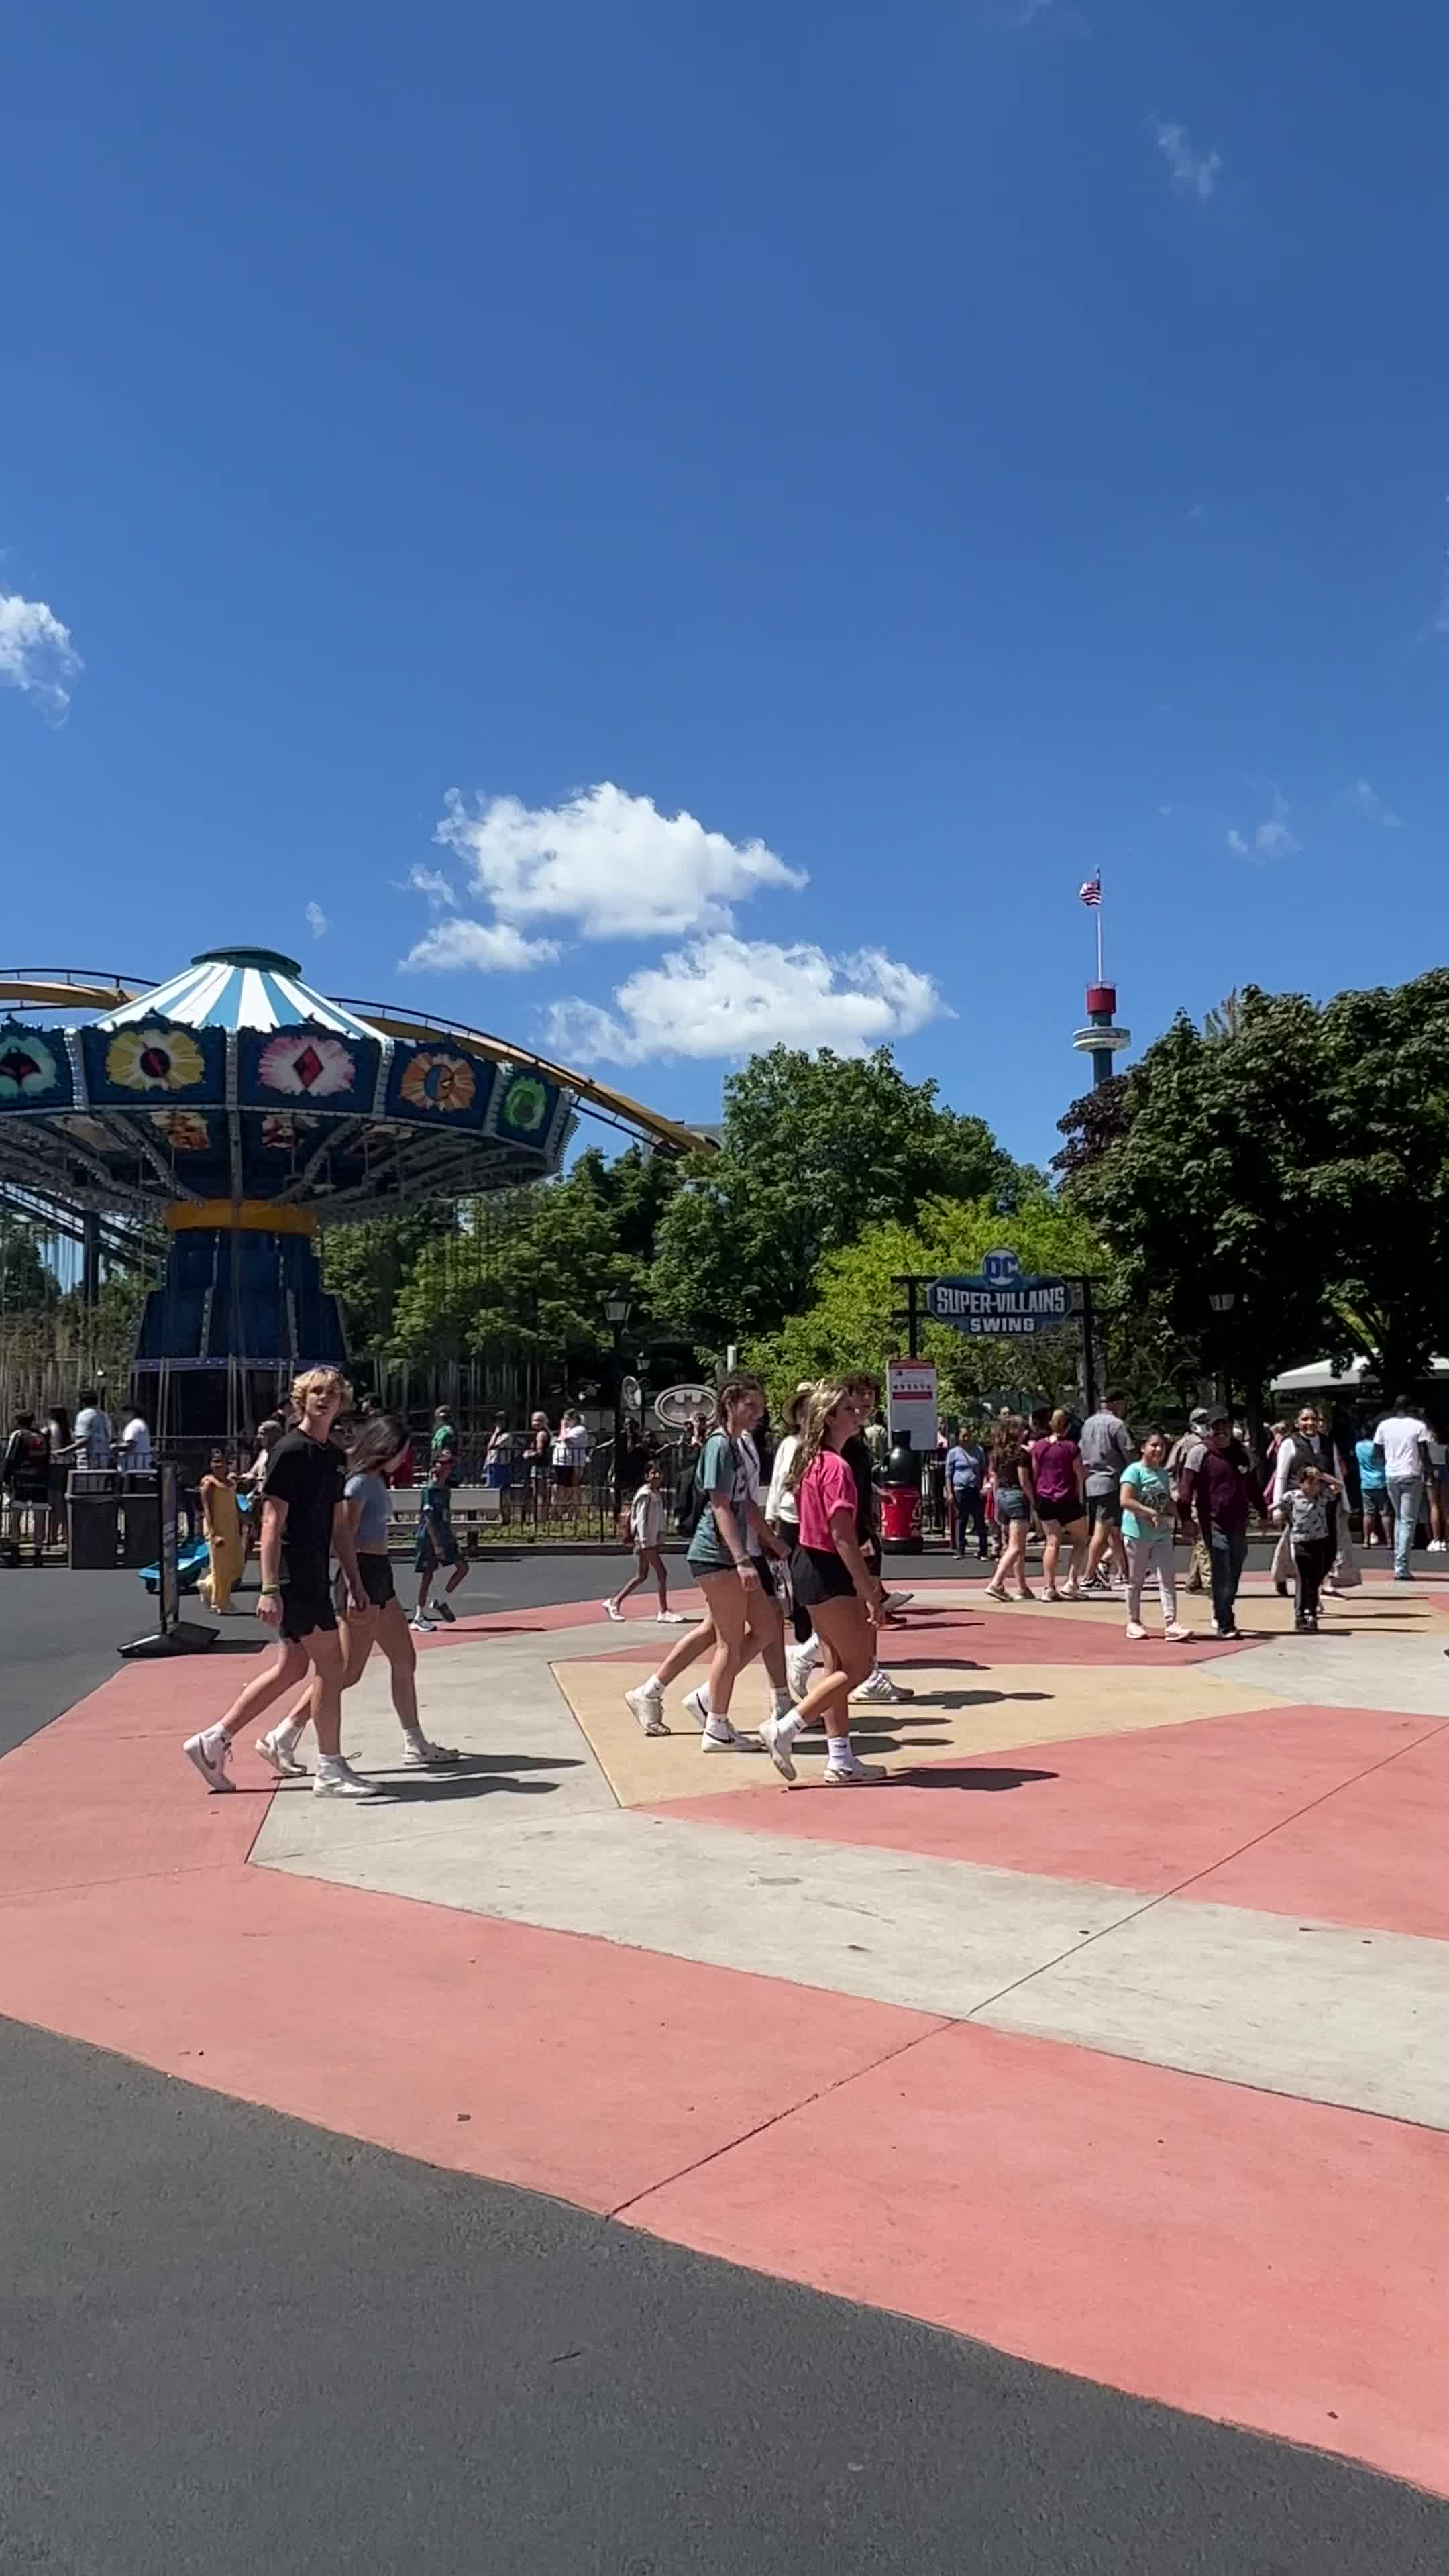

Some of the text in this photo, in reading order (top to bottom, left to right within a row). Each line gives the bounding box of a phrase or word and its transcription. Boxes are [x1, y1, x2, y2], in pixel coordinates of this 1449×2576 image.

[985, 1256, 1018, 1278] DC
[936, 1286, 1065, 1314] SUPER-VILLAINS
[970, 1317, 1035, 1332] SWING
